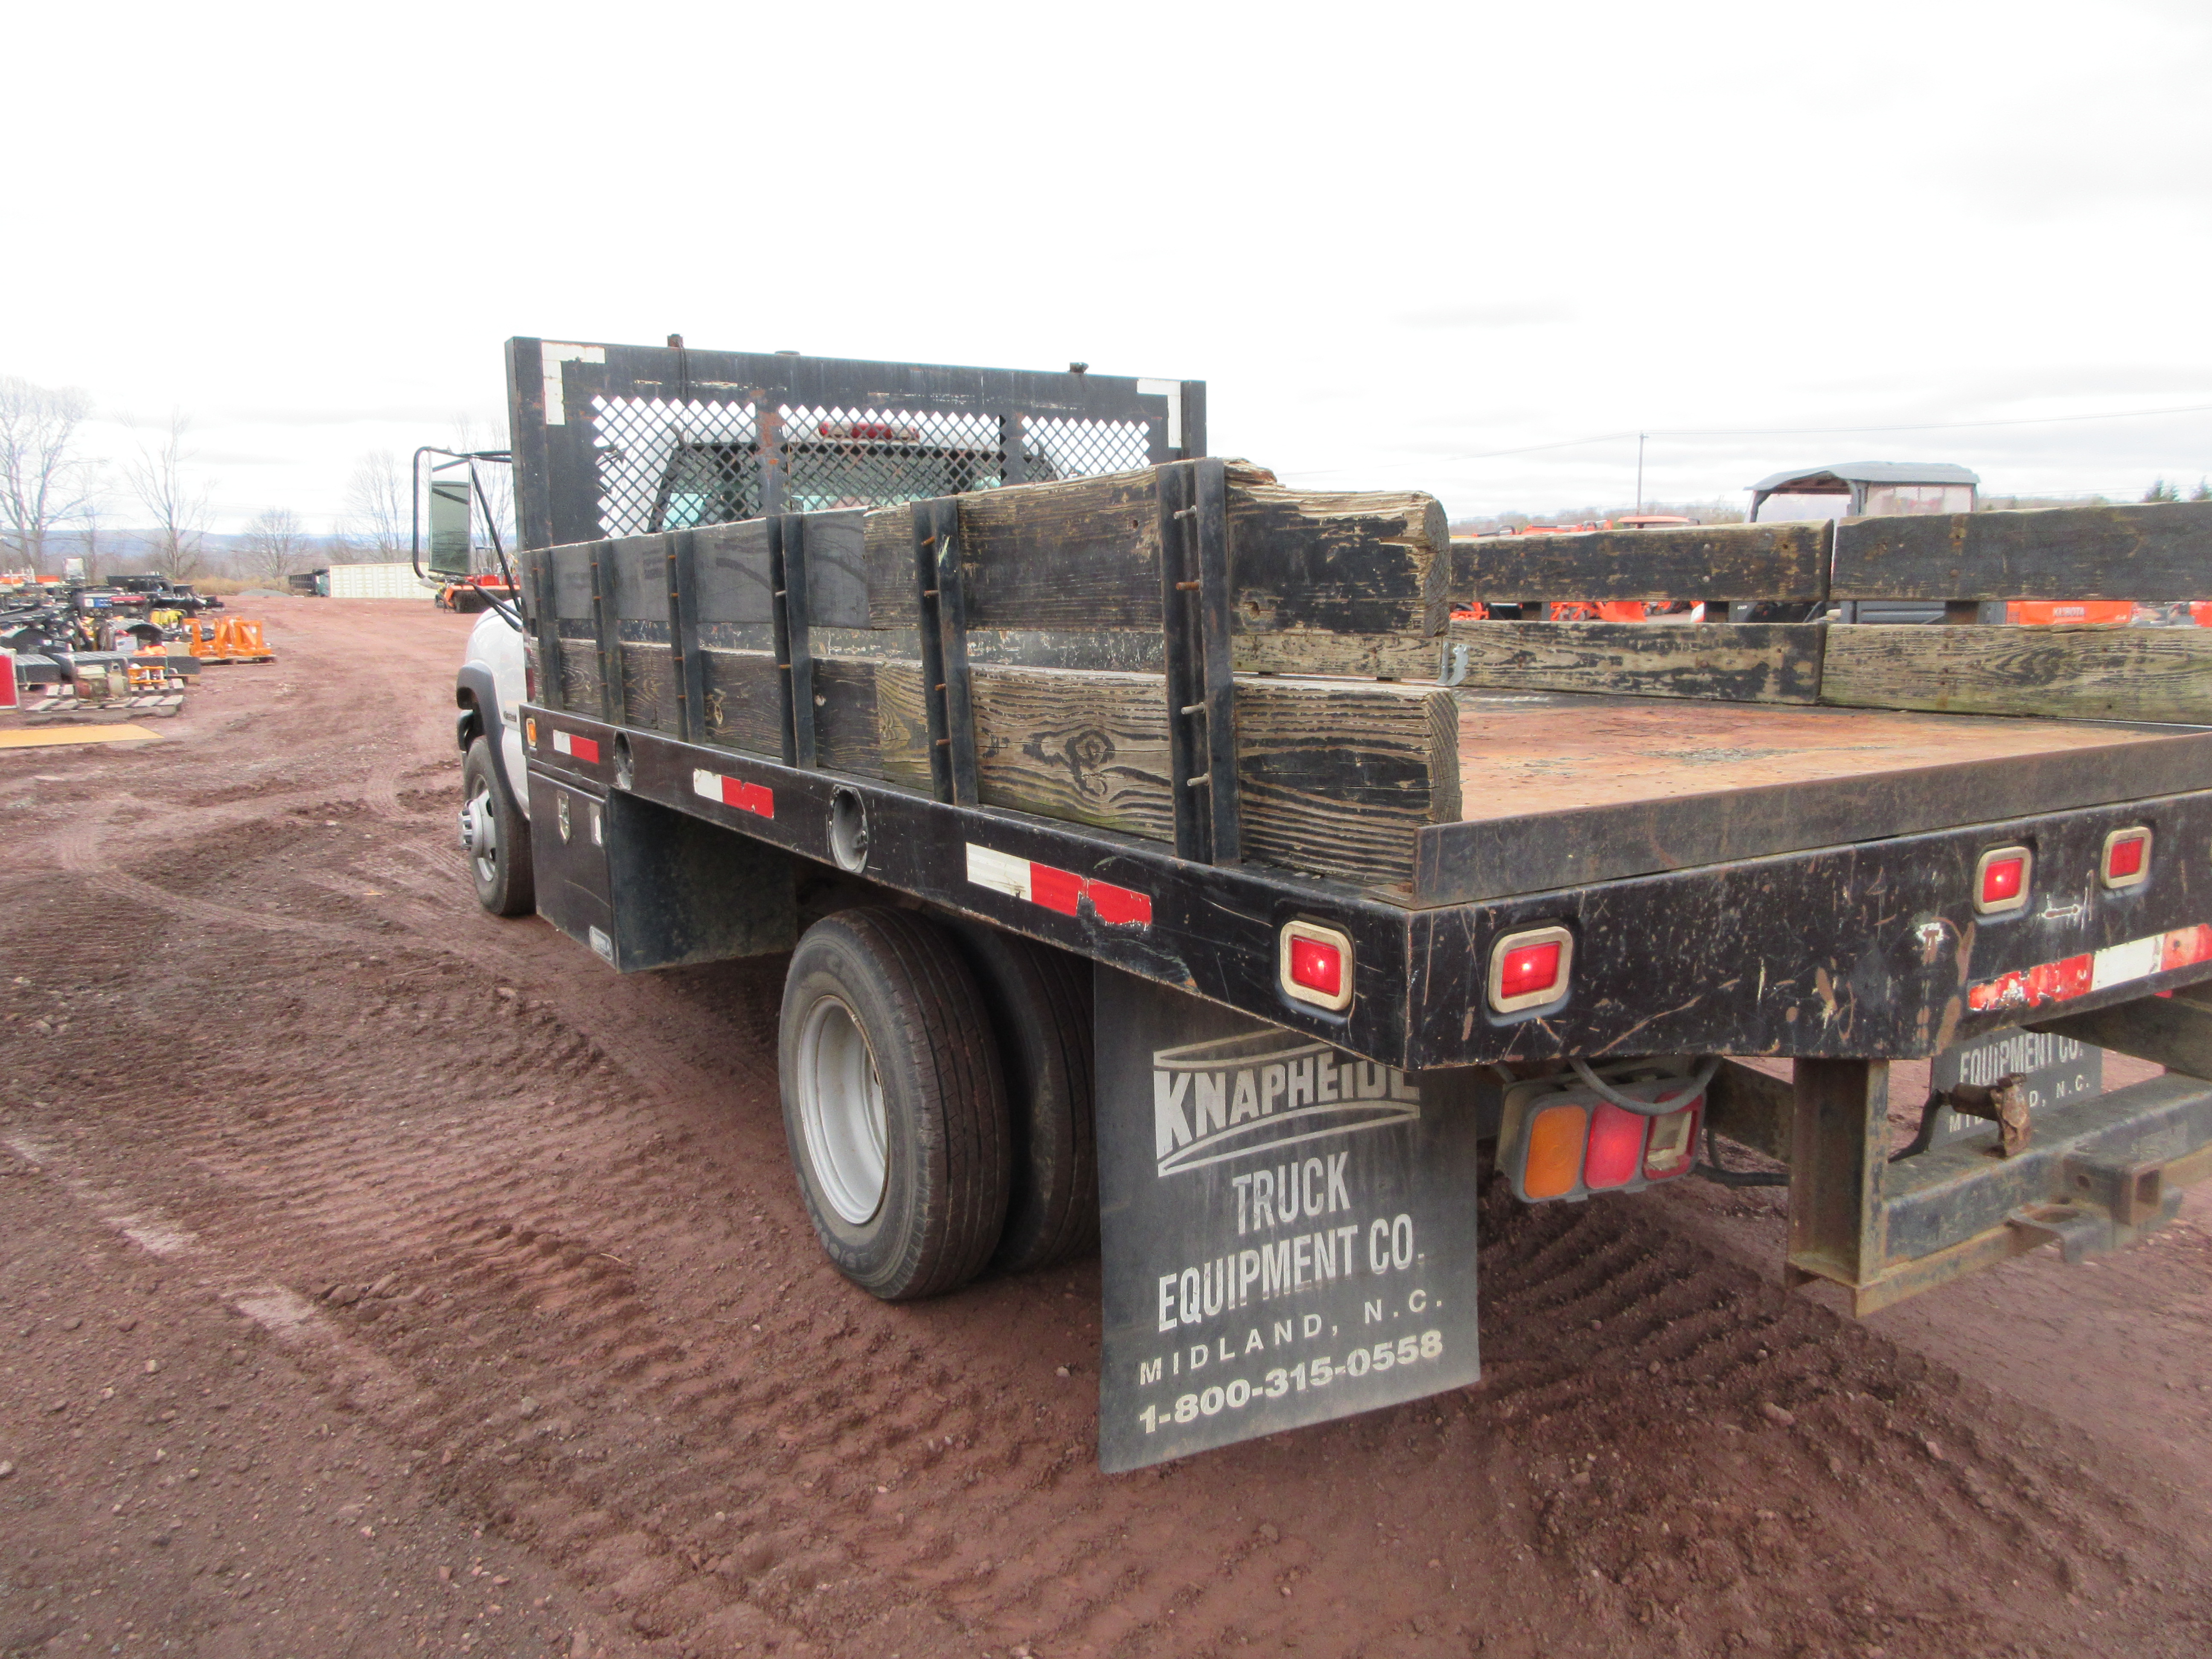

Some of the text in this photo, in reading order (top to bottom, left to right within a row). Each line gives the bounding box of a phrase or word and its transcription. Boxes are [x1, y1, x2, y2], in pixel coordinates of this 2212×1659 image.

[1232, 1152, 1350, 1234] TRUCK
[1158, 1214, 1426, 1332] EQUIPMENT CO.
[1139, 1330, 1444, 1433] 1-800-315-0558
[1140, 1313, 1339, 1384] MIDLAND,
